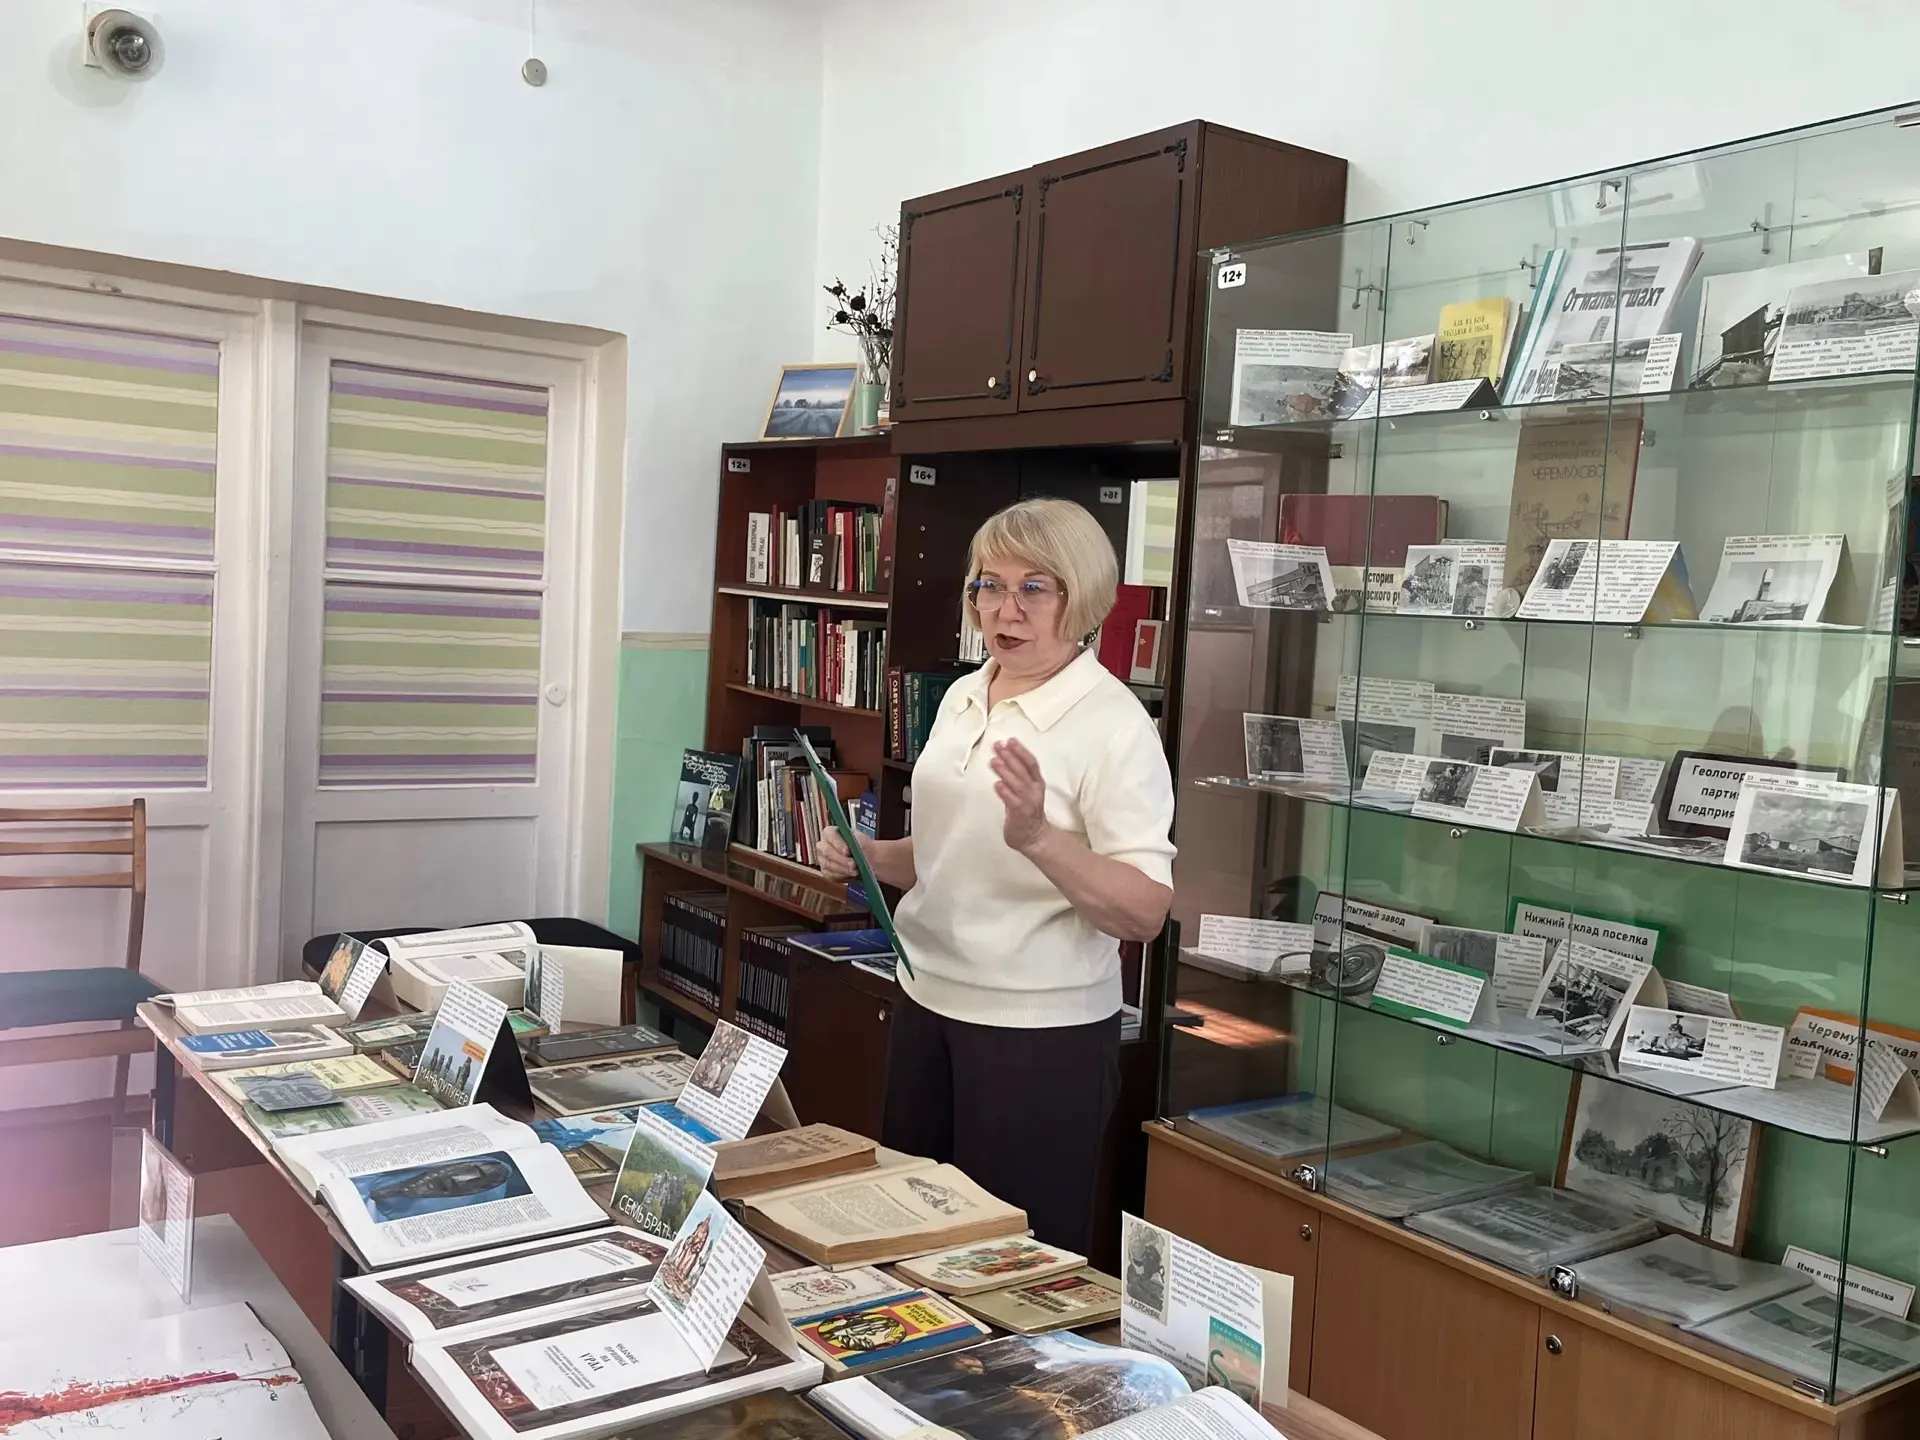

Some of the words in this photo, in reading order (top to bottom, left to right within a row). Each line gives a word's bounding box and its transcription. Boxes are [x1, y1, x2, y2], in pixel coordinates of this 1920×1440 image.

[1221, 270, 1243, 283] 12+
[1562, 286, 1580, 312] От
[1625, 287, 1665, 308] шахт
[731, 460, 748, 470] 12+
[1532, 464, 1606, 481] ЧЕРЕМУХОВО
[914, 468, 933, 481] 16+
[1381, 913, 1406, 927] завод
[1524, 910, 1565, 929] Нижний
[1567, 922, 1600, 937] склад
[1602, 929, 1649, 946] поселка
[618, 1193, 644, 1225] СЕМЬ
[1796, 1261, 1815, 1274] Имя
[1861, 1284, 1895, 1302] поселка
[577, 1352, 604, 1372] УРАЛ
